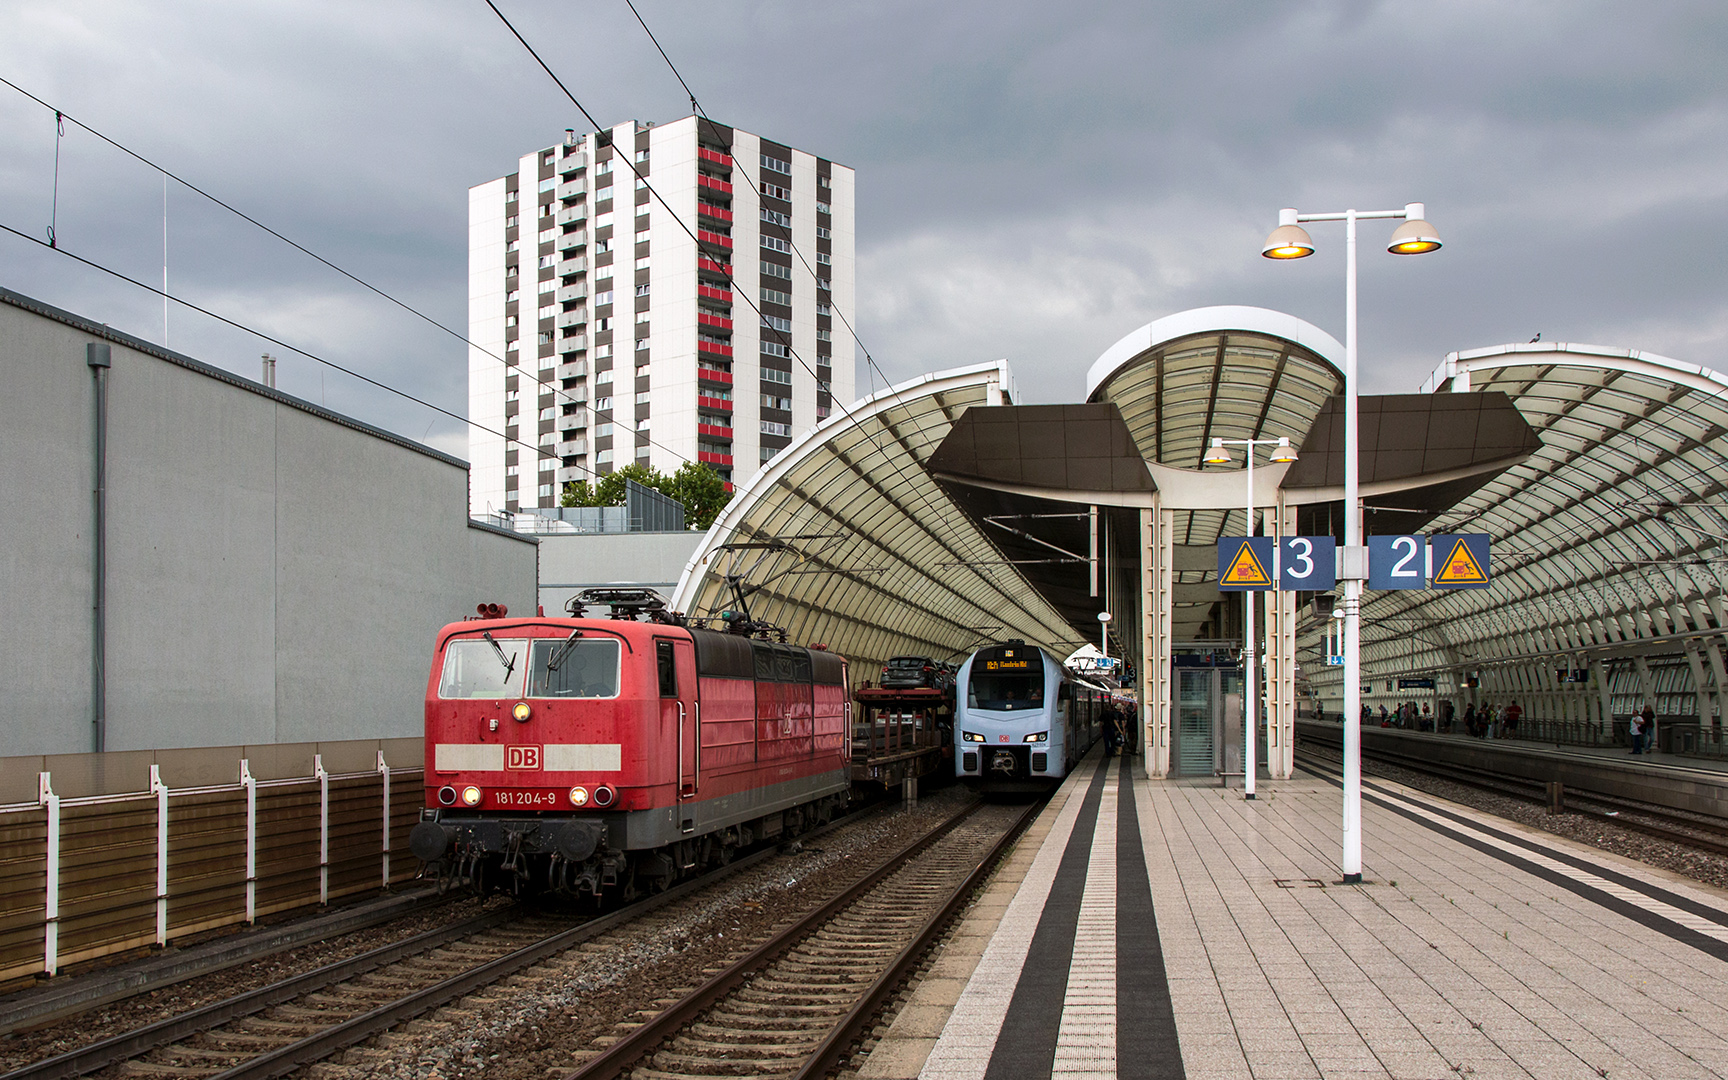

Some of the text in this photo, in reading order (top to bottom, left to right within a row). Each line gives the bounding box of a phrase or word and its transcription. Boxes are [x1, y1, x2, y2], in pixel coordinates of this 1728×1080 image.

[1287, 537, 1315, 579] 3
[1390, 536, 1419, 578] 2
[1129, 667, 1136, 679] 3
[509, 748, 538, 768] DB
[495, 792, 556, 805] 181 204-9
